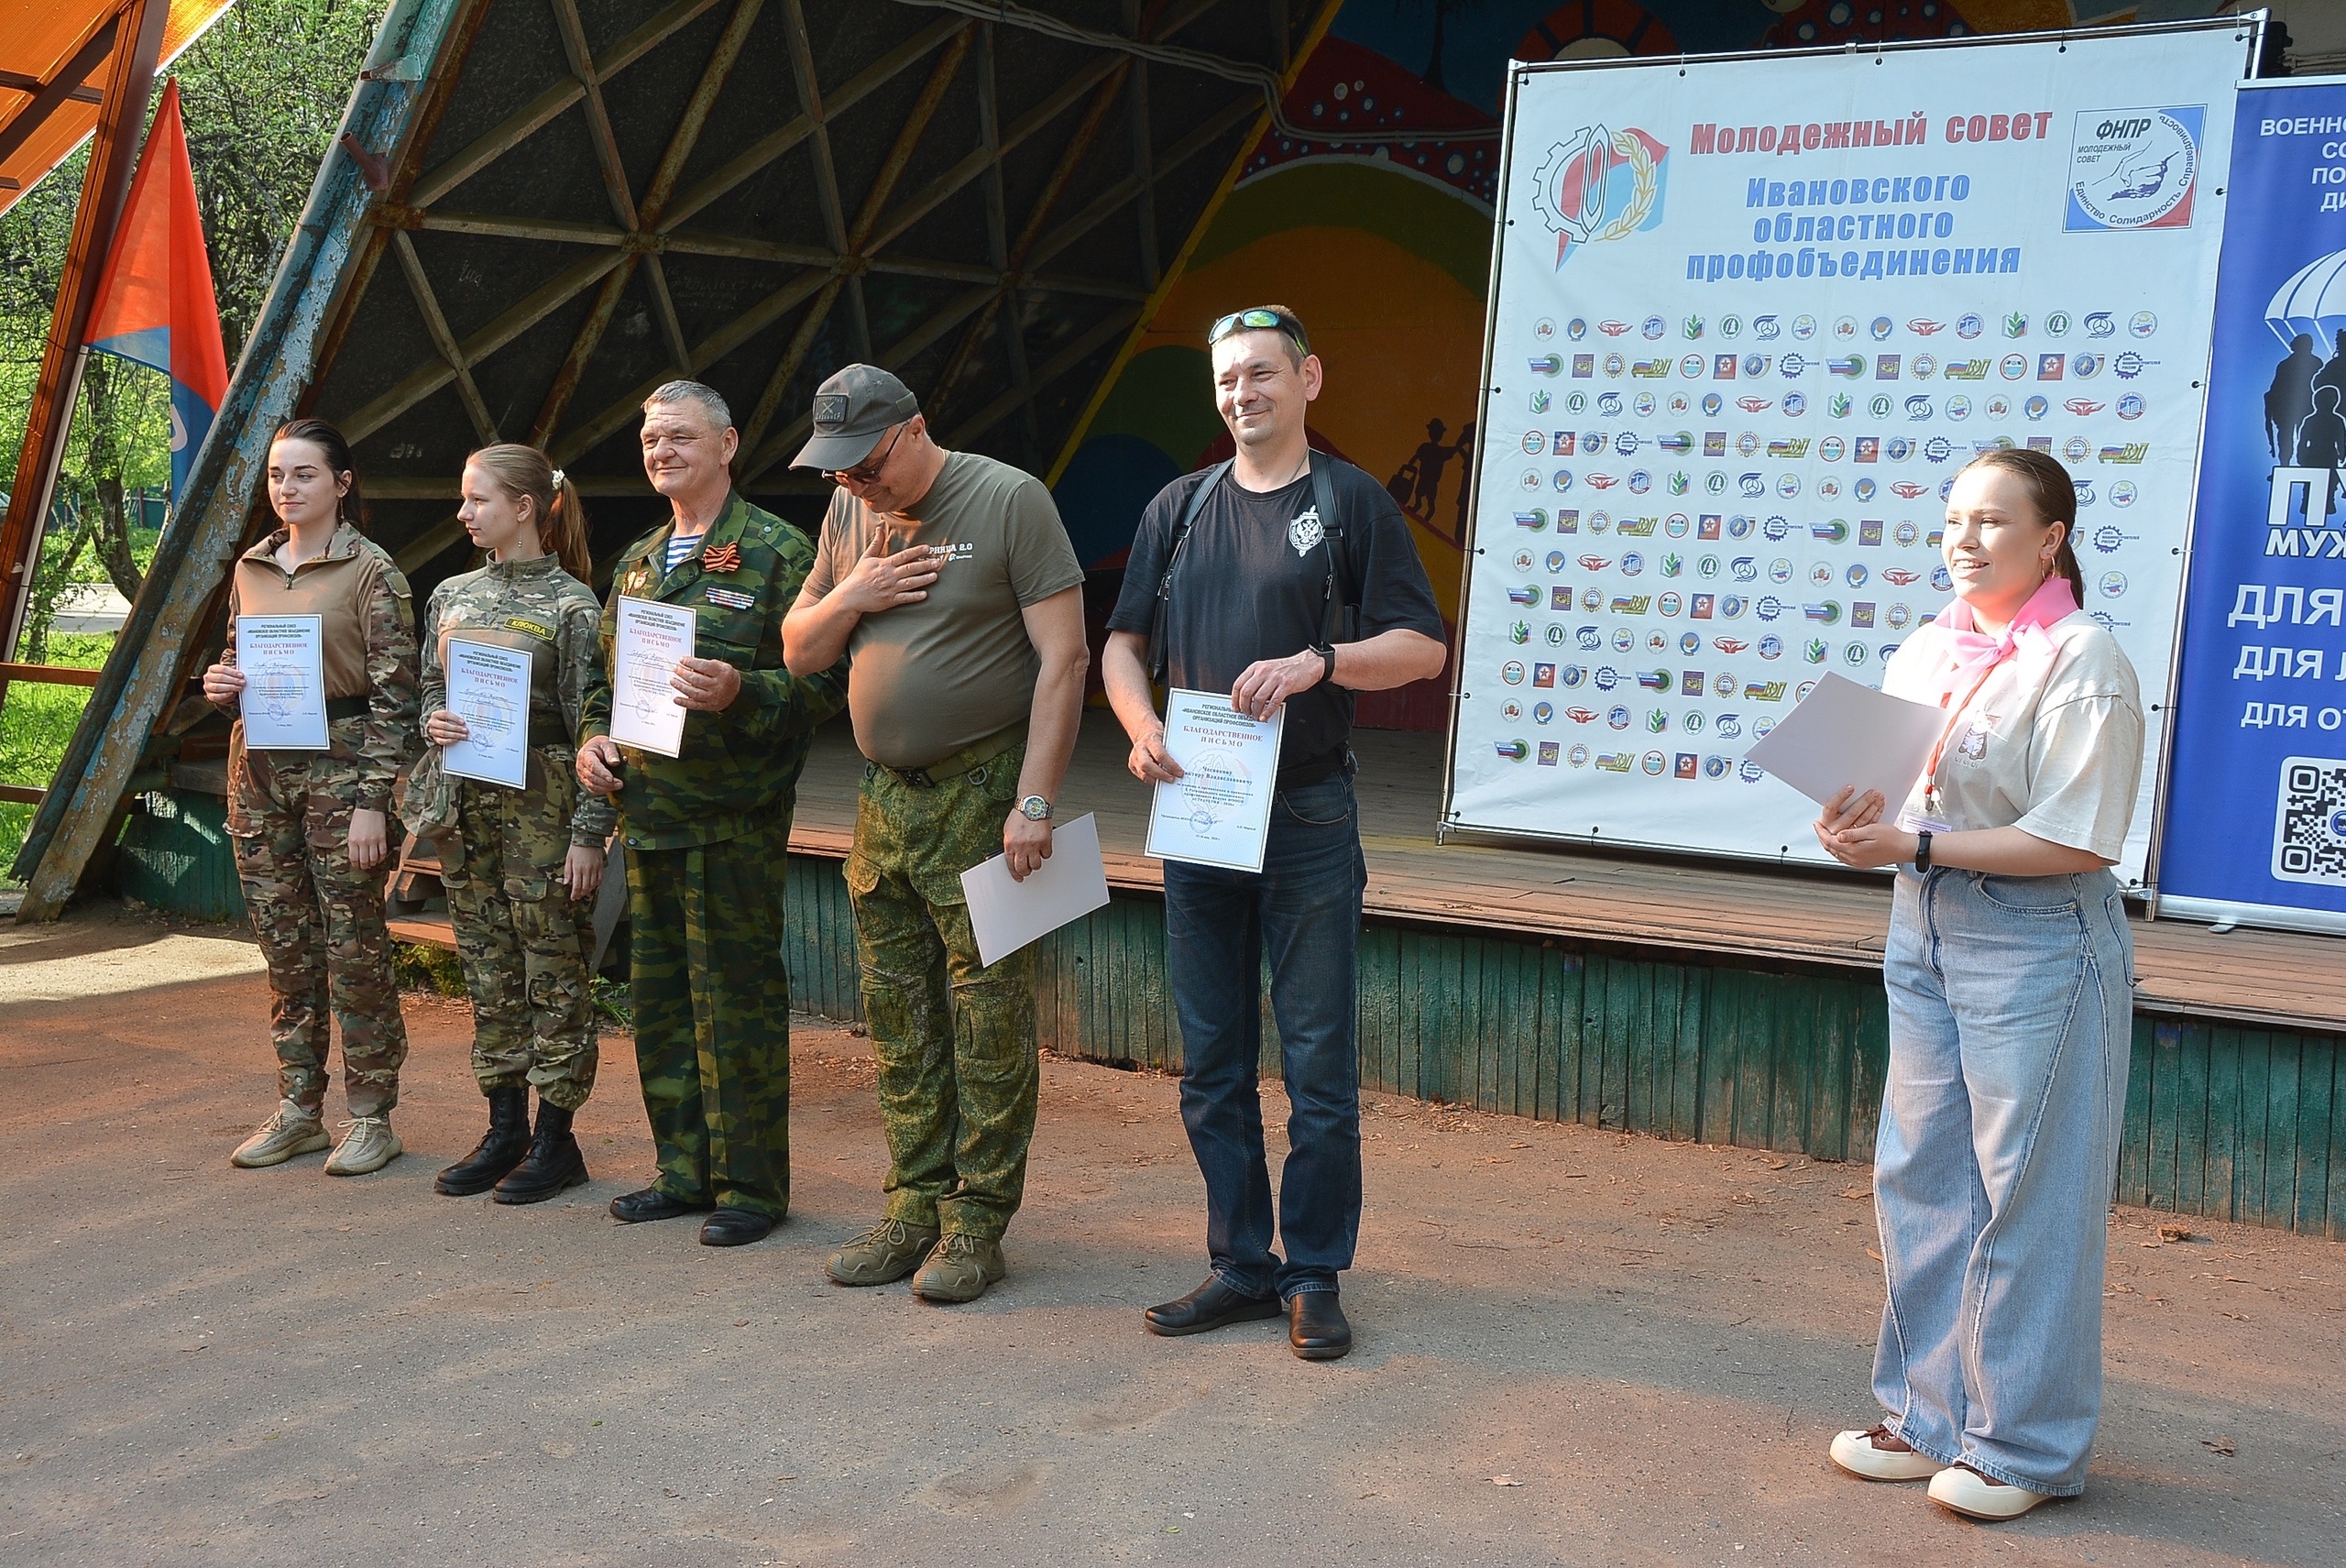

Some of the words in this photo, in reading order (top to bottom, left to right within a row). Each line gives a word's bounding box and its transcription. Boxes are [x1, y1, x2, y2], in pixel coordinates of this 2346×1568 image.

[1690, 111, 1928, 156] Молодежный
[1945, 111, 2054, 144] совет
[2096, 118, 2152, 140] ФНПР
[2260, 116, 2346, 136] ВОЕНН
[2077, 142, 2132, 154] МОЛОДЕЖНЫЙ
[2077, 155, 2100, 163] СОВЕТ
[2076, 181, 2105, 220] Единство
[2109, 191, 2181, 225] Солидарность
[2159, 115, 2194, 187] Справедливость
[1746, 173, 1971, 208] Ивановского
[1753, 211, 1955, 244] областного
[1686, 246, 2022, 283] профобъединения
[2227, 585, 2344, 630] ДЛЯ
[511, 620, 546, 636] КЛЮКВА
[2232, 645, 2324, 681] ДЛЯ
[475, 677, 505, 687] ПИСЬМО
[1184, 726, 1263, 742] БЛАГОДАРСТВЕННОЕ
[1200, 736, 1243, 747] ПИСЬМО
